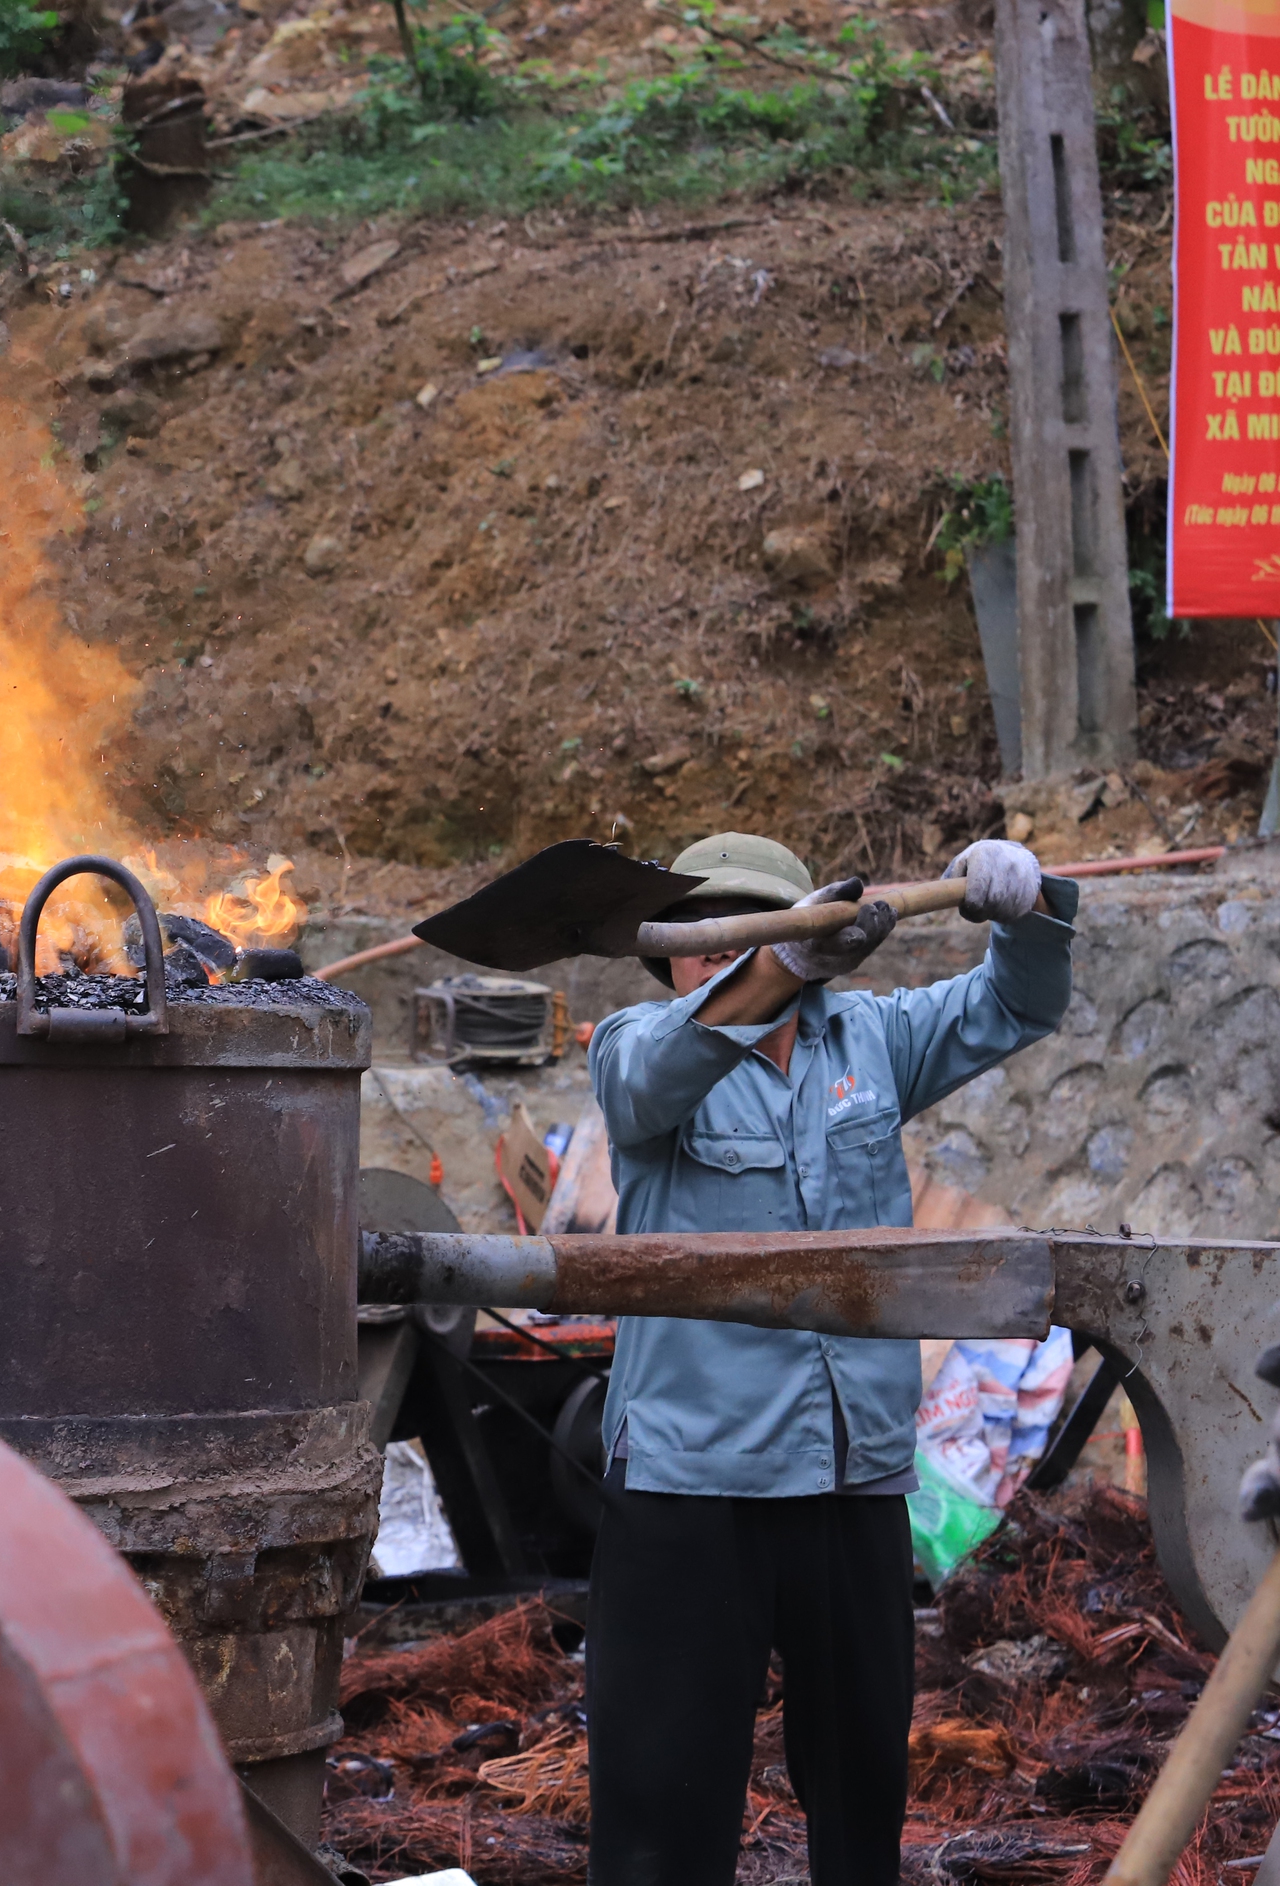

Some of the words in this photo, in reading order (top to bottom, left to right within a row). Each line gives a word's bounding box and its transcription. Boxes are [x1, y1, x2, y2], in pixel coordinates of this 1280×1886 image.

[1204, 64, 1234, 100] LỄ
[1245, 158, 1280, 185] NG
[1205, 192, 1258, 229] CỦA
[1218, 235, 1268, 270] TẢN
[1241, 281, 1280, 313] NĂ
[1208, 323, 1243, 356] VÀ
[1211, 370, 1252, 403] TẠI
[1205, 409, 1241, 440] XÃ
[1246, 413, 1280, 440] MI
